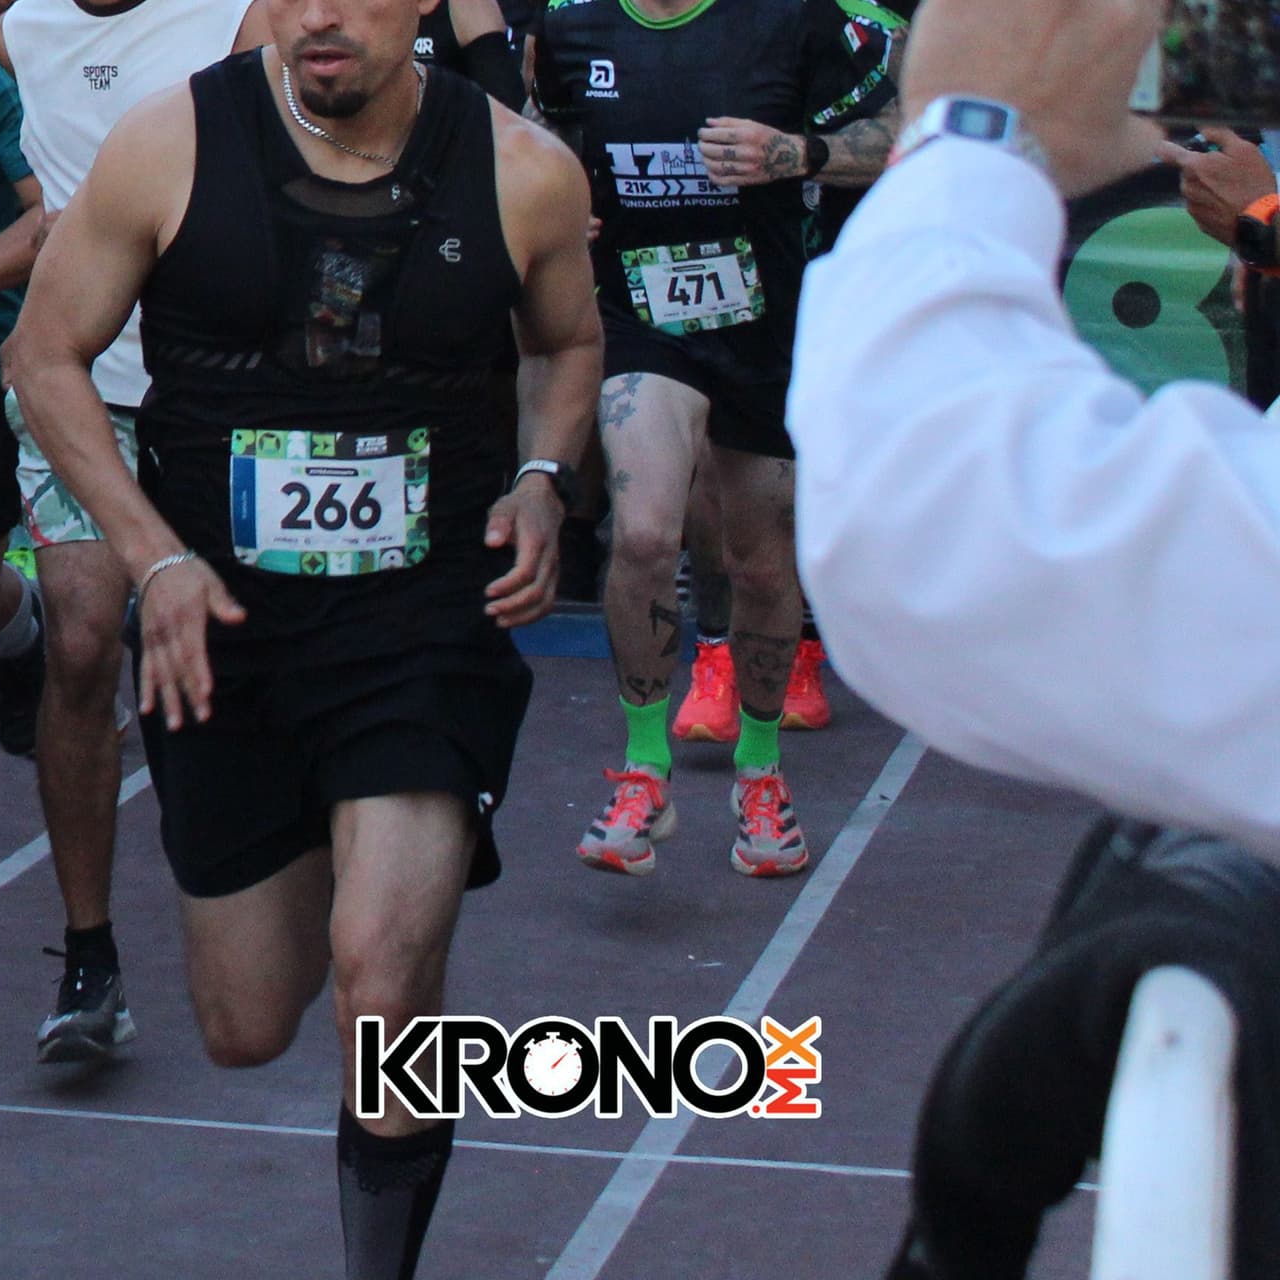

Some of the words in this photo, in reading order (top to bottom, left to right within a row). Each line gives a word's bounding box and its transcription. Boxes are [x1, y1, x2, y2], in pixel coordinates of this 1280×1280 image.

[82, 65, 119, 79] SPORTS
[88, 78, 111, 91] TEAM
[585, 90, 620, 99] APODACA
[624, 181, 653, 194] 21K
[697, 180, 722, 193] 5K
[620, 196, 680, 209] FUNDACIÓN
[683, 197, 740, 207] APODACA
[667, 271, 725, 306] 471
[280, 481, 382, 531] 266
